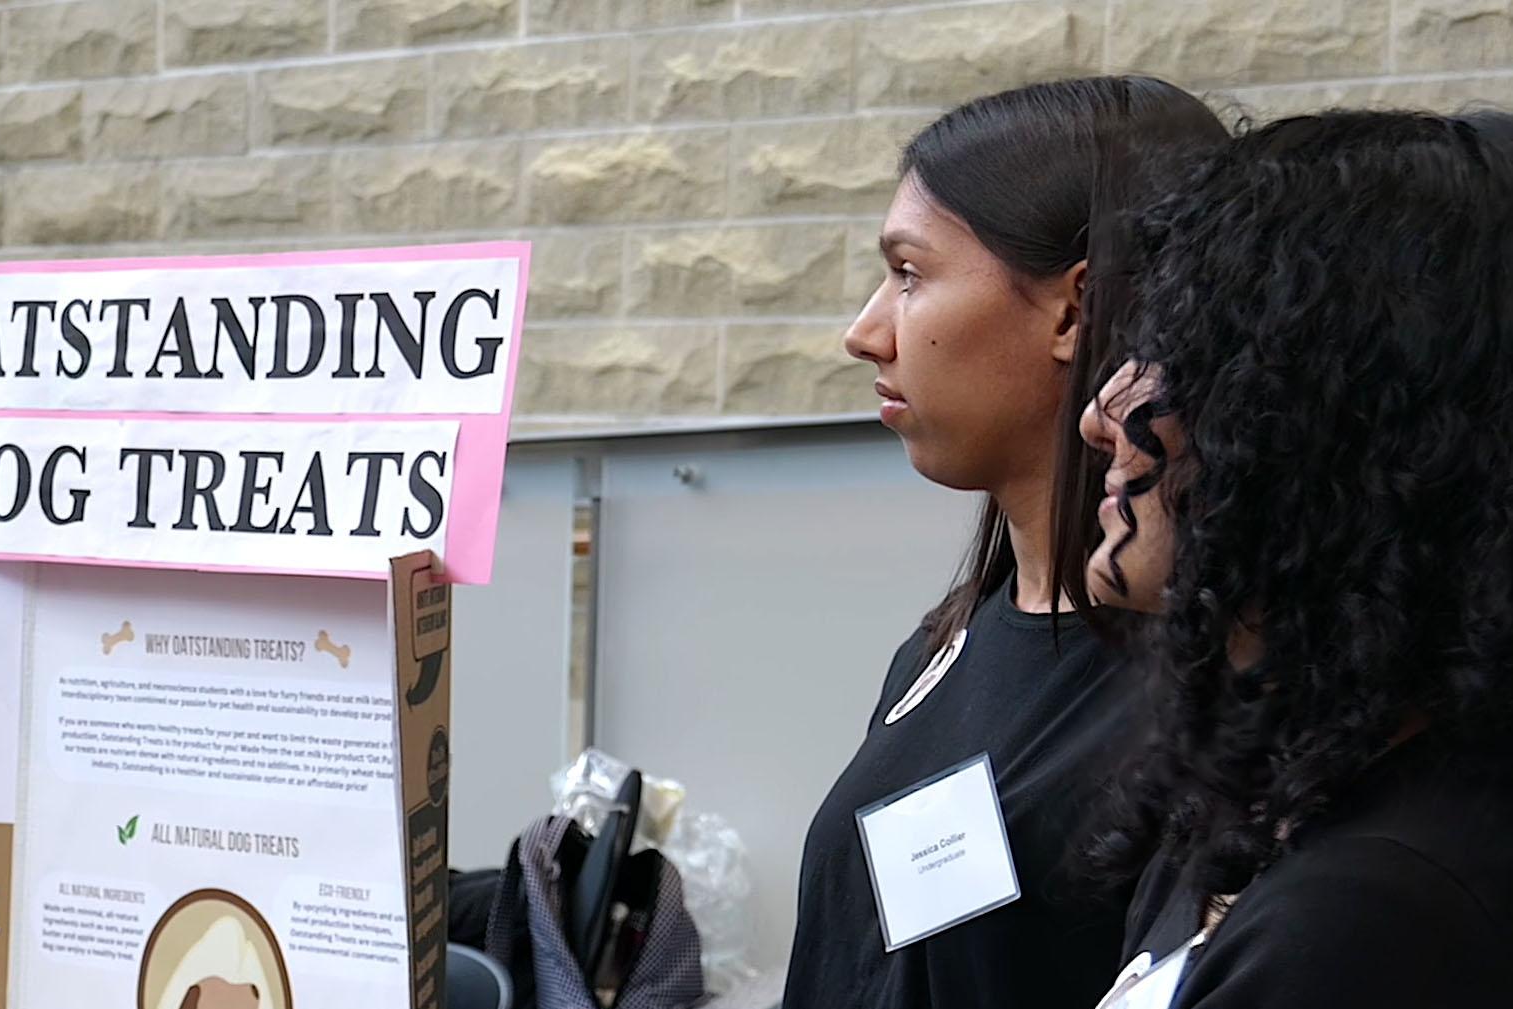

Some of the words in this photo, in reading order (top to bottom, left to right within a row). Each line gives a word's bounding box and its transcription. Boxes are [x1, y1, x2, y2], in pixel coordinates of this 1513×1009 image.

[119, 447, 447, 541] TREATS
[145, 633, 169, 654] WHY
[172, 634, 250, 659] OATSTANDING
[254, 638, 305, 662] TREATS?
[151, 822, 170, 845] ALL
[174, 825, 222, 850] NATURAL
[227, 830, 251, 853] DOG
[254, 833, 299, 858] TREATS
[911, 843, 940, 862] Jessica
[939, 831, 967, 849] Collier
[917, 849, 966, 875] Undergraduate
